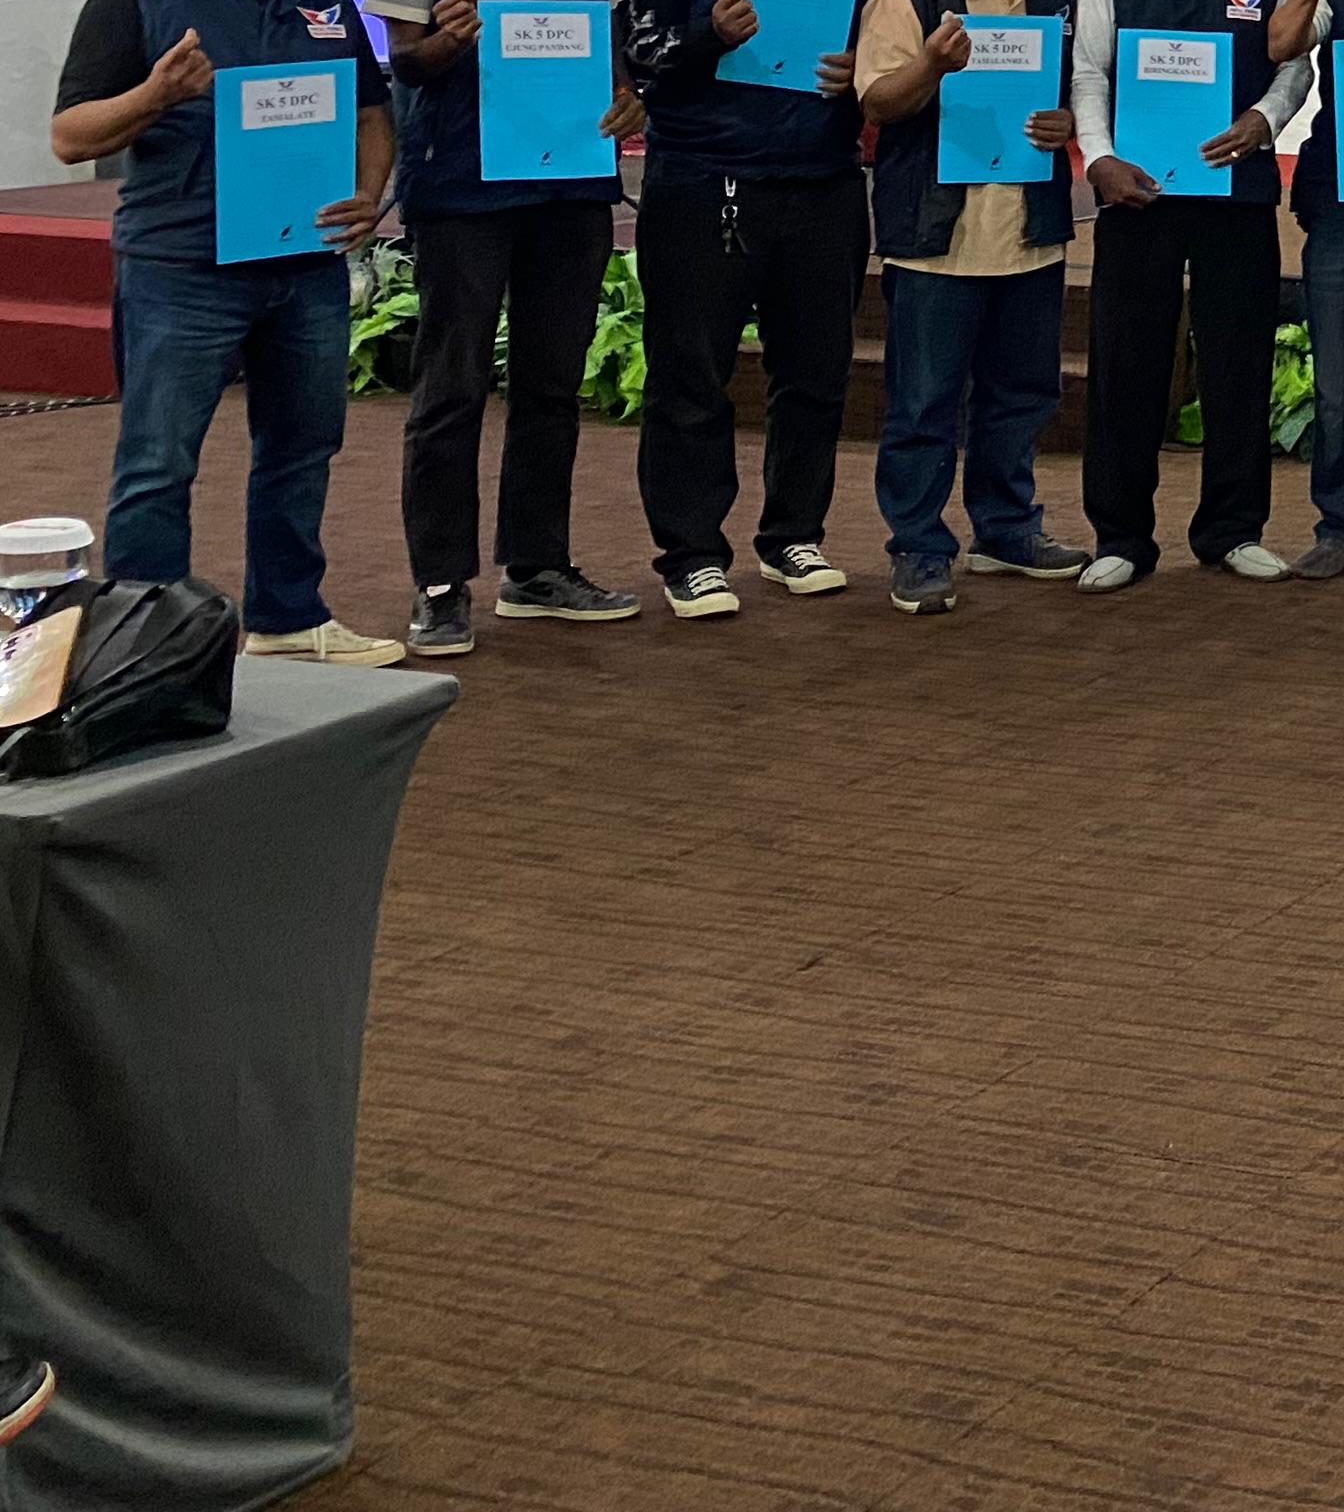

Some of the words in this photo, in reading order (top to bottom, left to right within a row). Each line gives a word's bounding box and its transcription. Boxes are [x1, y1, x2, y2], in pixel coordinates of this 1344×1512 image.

[514, 29, 533, 40] SK
[536, 29, 543, 40] 5
[545, 29, 575, 40] DPC
[974, 43, 990, 54] SK
[992, 43, 999, 54] 5
[1001, 44, 1028, 54] DPC
[1150, 54, 1167, 65] SK
[1168, 55, 1176, 65] 5
[1178, 56, 1202, 67] DPC
[254, 97, 275, 110] SK
[278, 97, 287, 108] 5
[289, 92, 320, 107] DPC
